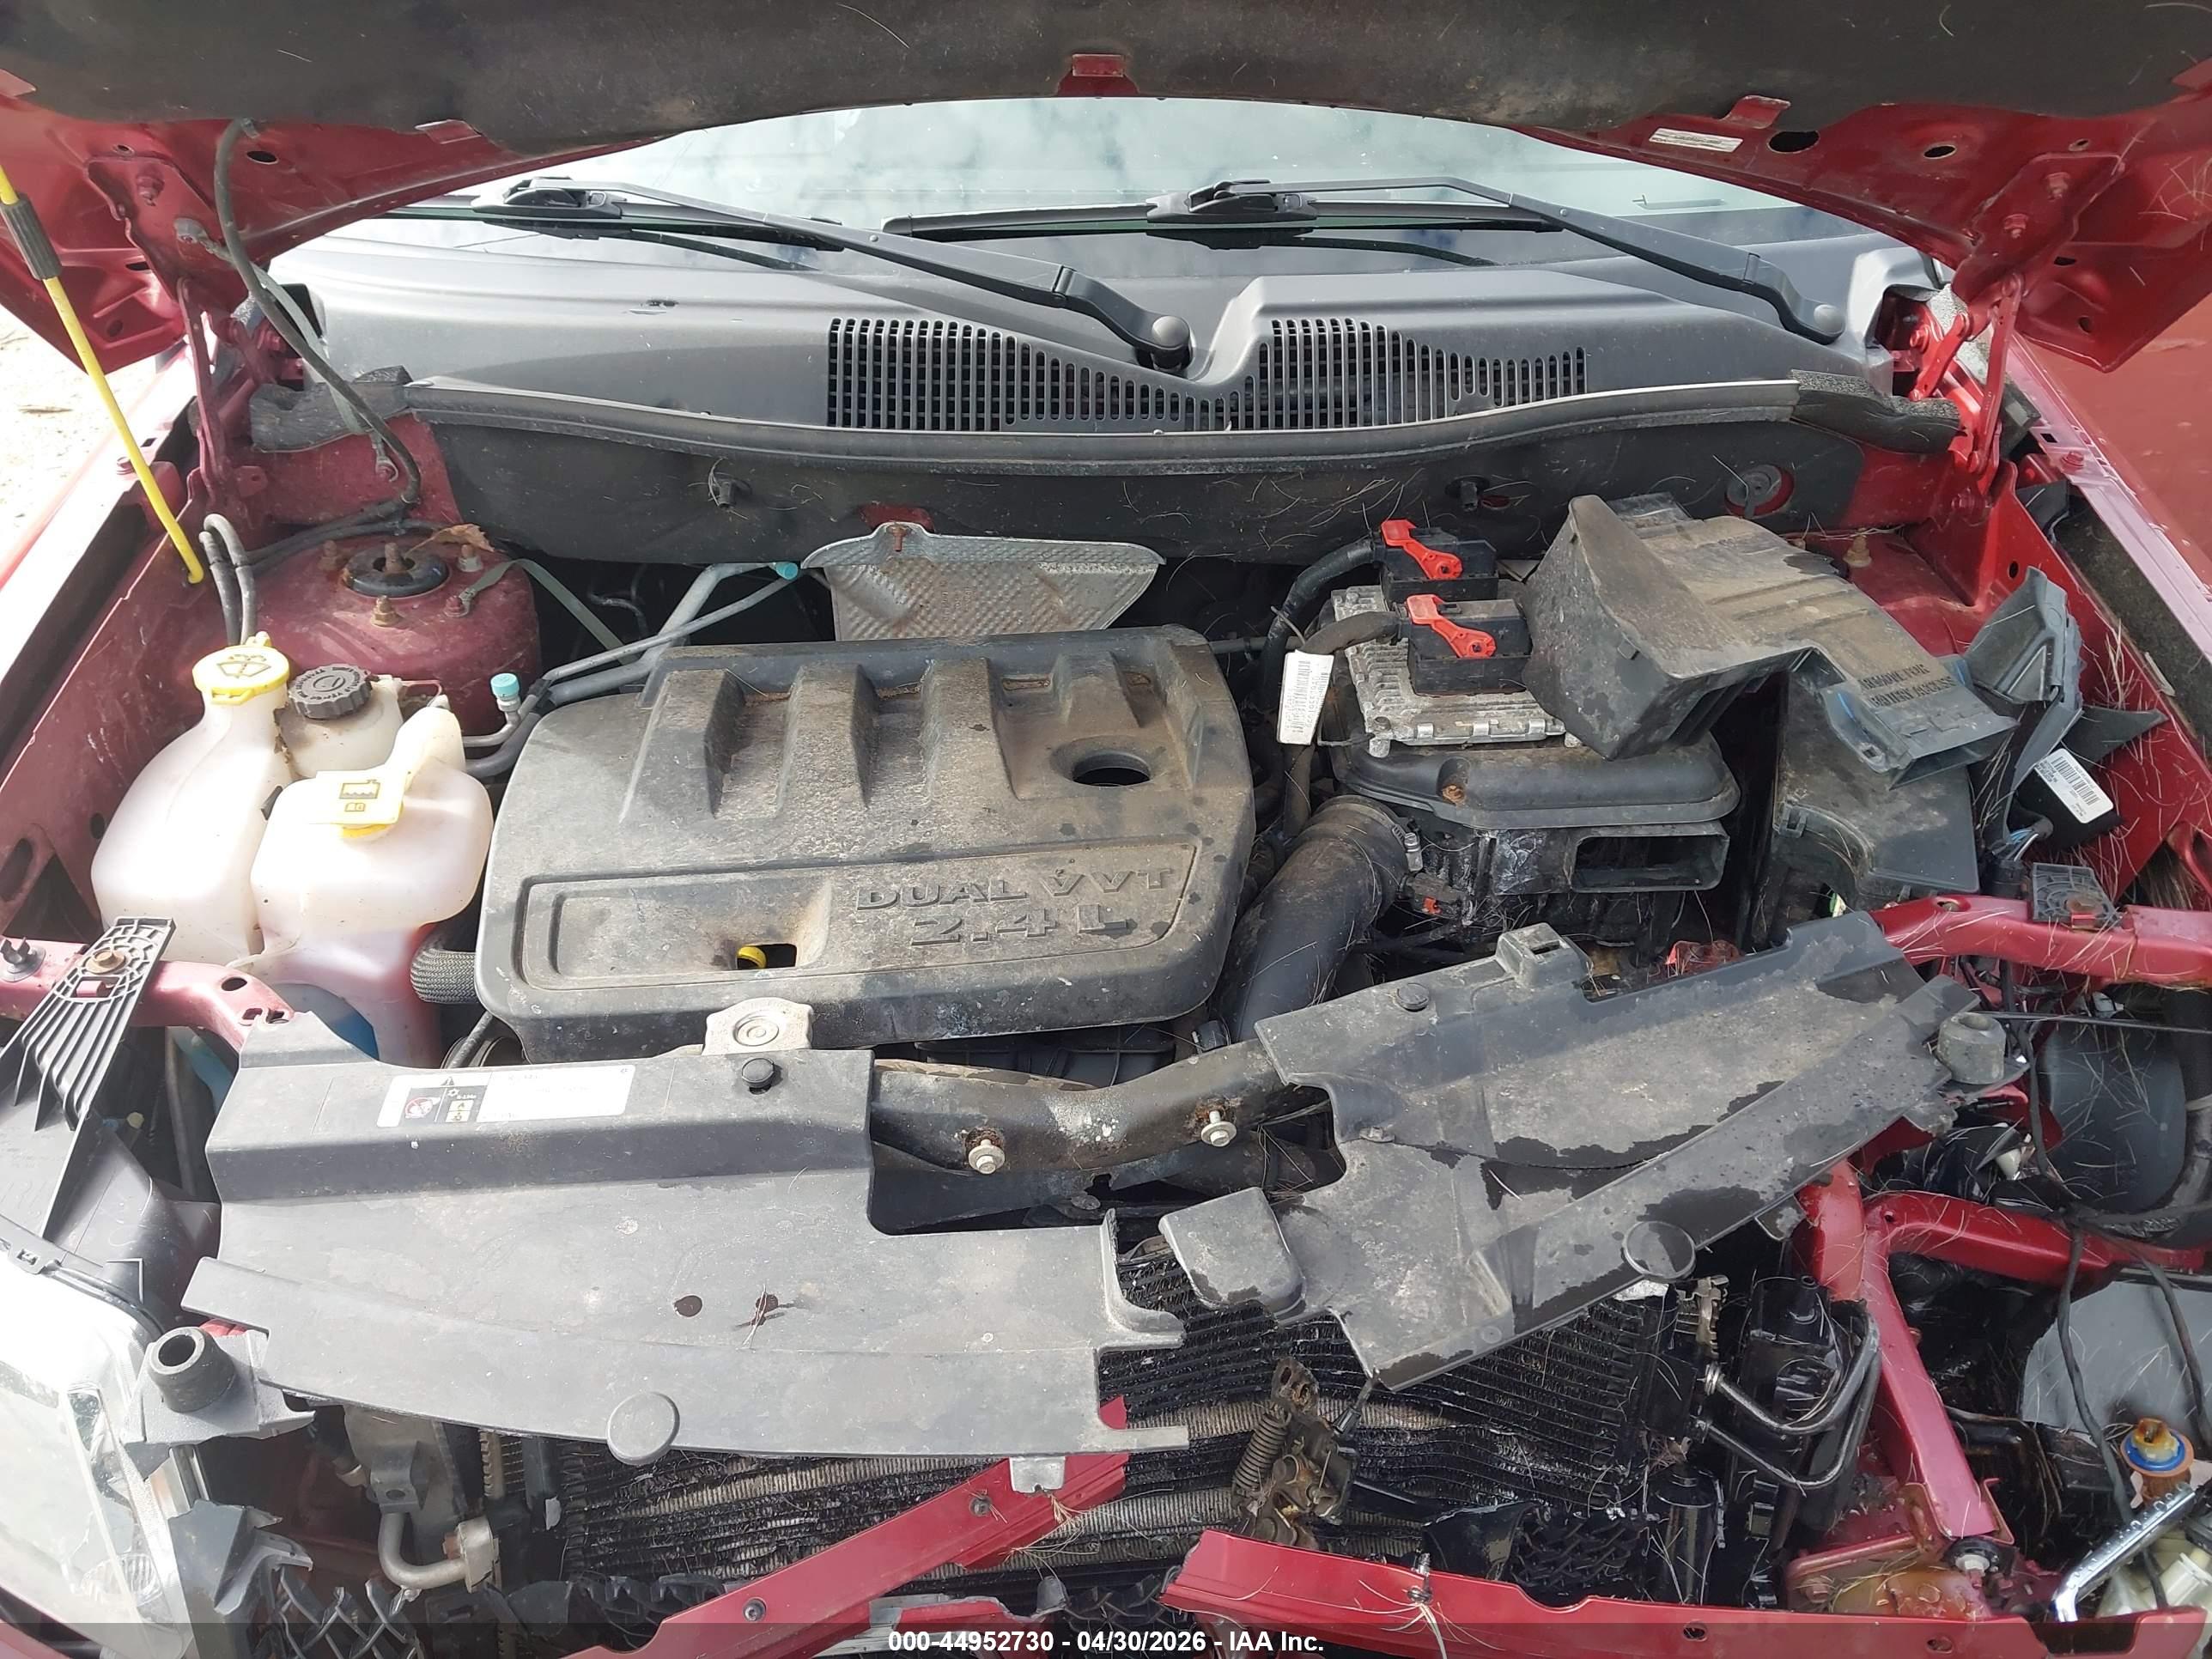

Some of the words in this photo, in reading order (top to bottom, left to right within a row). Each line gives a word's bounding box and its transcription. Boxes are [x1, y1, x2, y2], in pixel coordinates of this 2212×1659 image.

[1858, 672, 1906, 690] REMOVE
[1903, 664, 1929, 679] FOR
[1912, 676, 1956, 696] ACCESS
[857, 880, 1028, 911] DUAL
[1040, 868, 1172, 896] VVT
